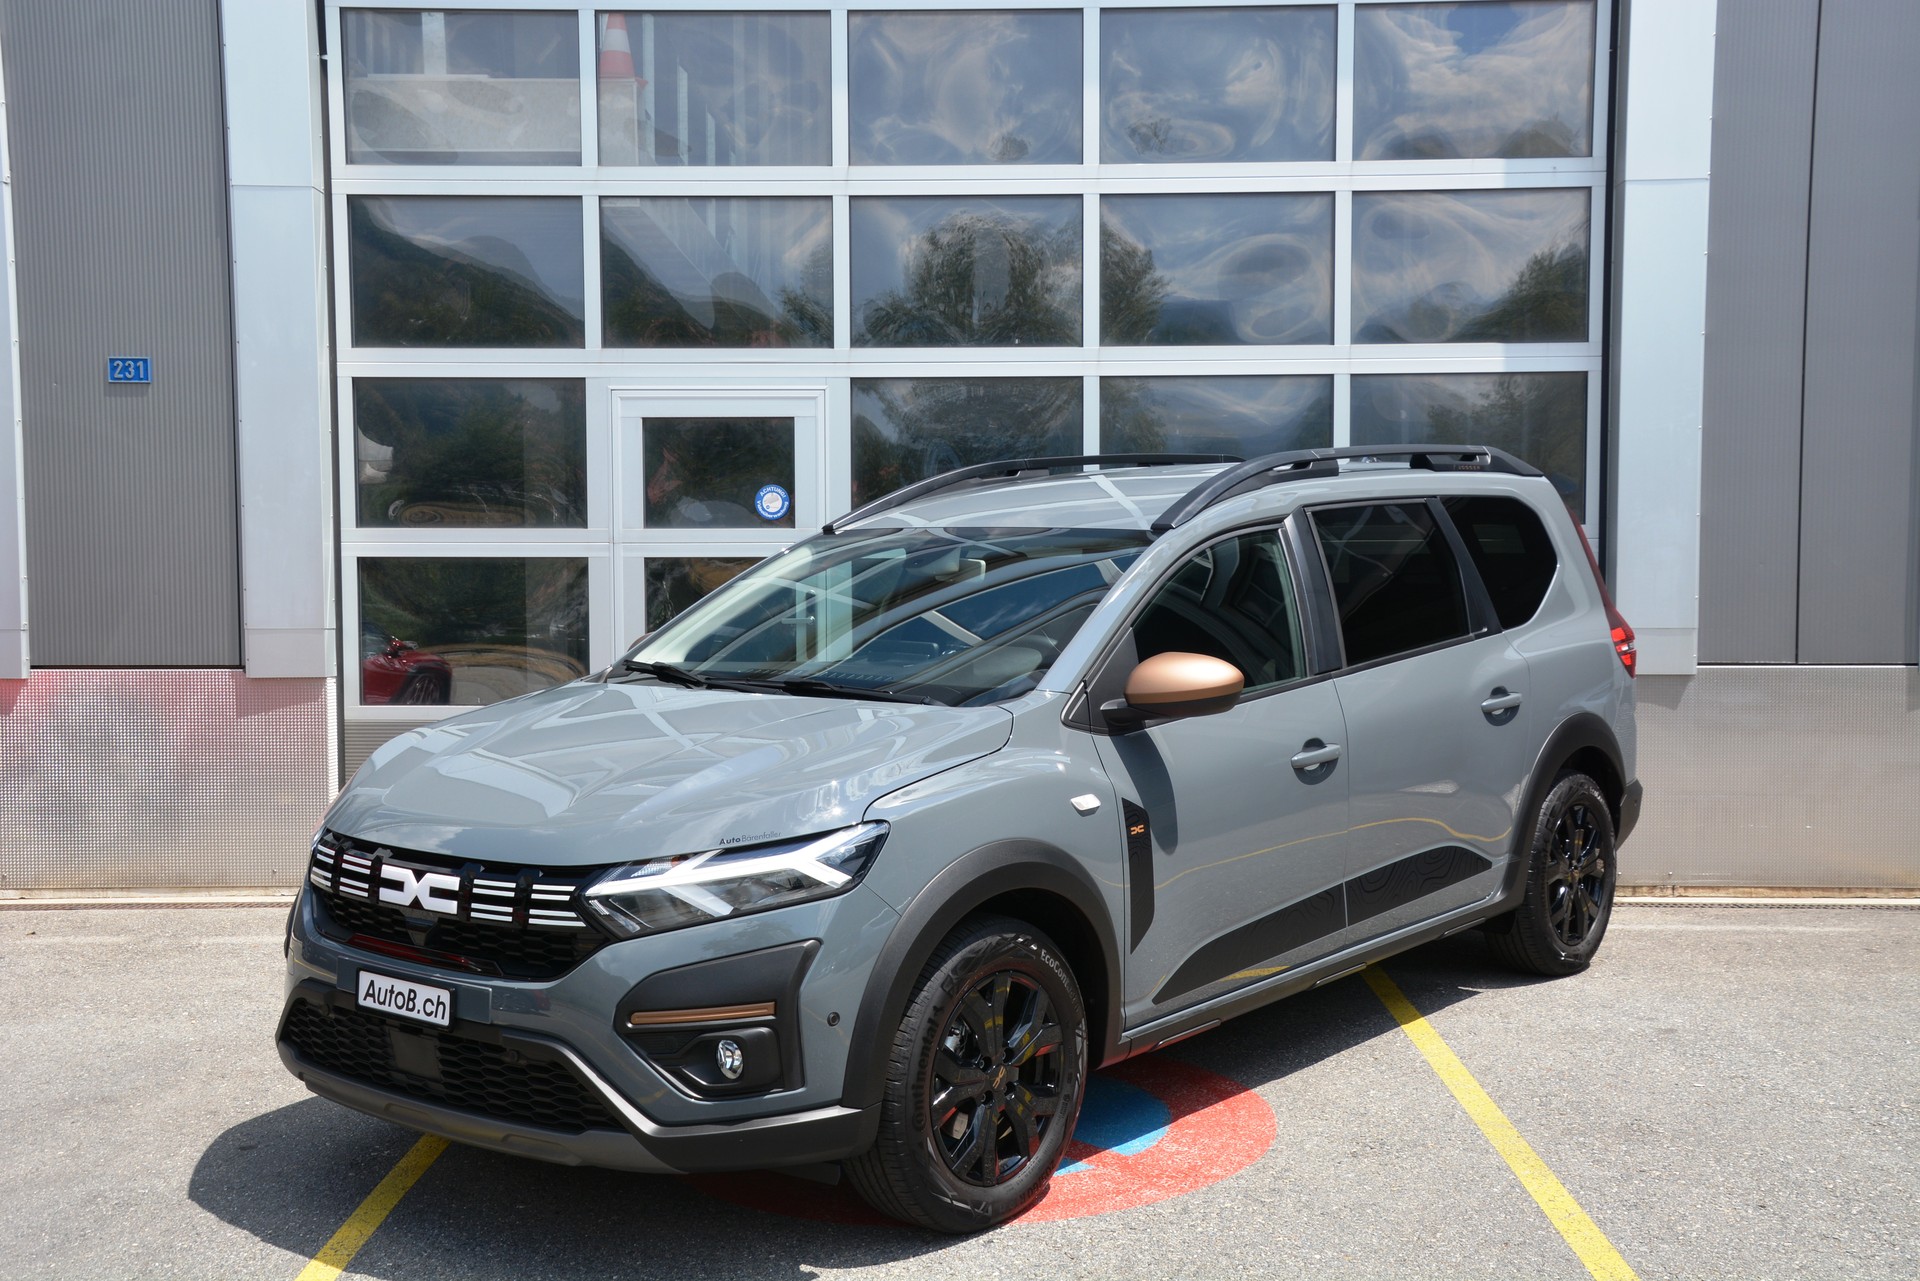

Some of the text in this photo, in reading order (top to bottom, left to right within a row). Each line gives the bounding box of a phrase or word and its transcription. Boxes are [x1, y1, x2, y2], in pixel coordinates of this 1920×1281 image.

[113, 360, 144, 379] 231
[760, 487, 786, 498] ACHTUNG!
[362, 979, 447, 1020] AutoB.ch
[911, 1017, 939, 1132] Continental
